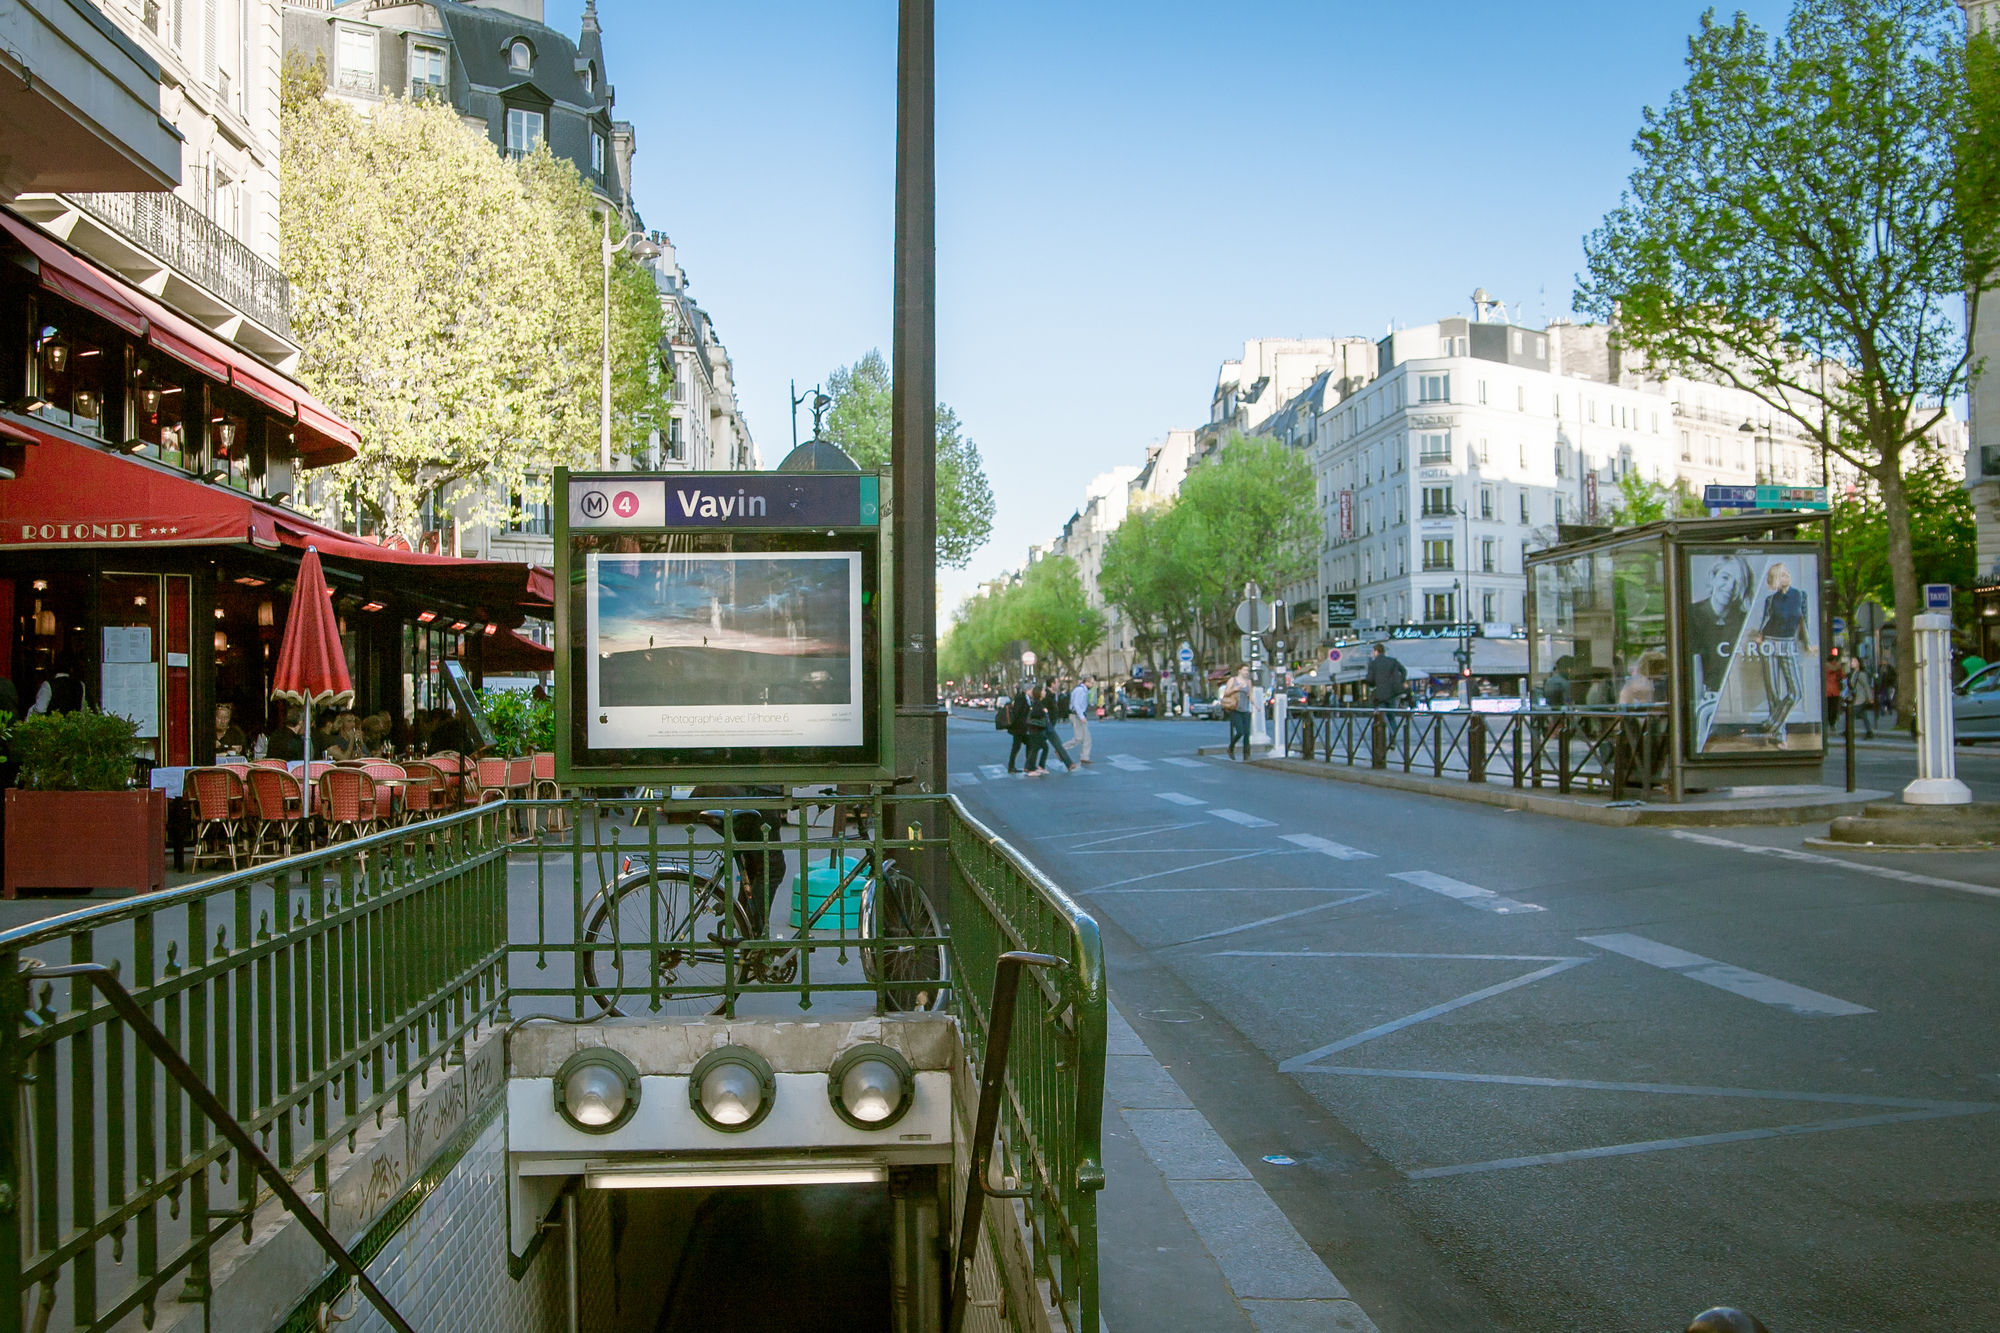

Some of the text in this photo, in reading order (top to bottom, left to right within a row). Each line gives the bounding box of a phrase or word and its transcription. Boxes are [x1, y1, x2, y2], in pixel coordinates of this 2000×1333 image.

[618, 496, 632, 513] 4
[22, 524, 142, 540] ROTONDE
[1717, 641, 1799, 657] CAROLL
[661, 712, 723, 728] Photographié
[725, 714, 744, 724] avec
[783, 713, 790, 723] 6
